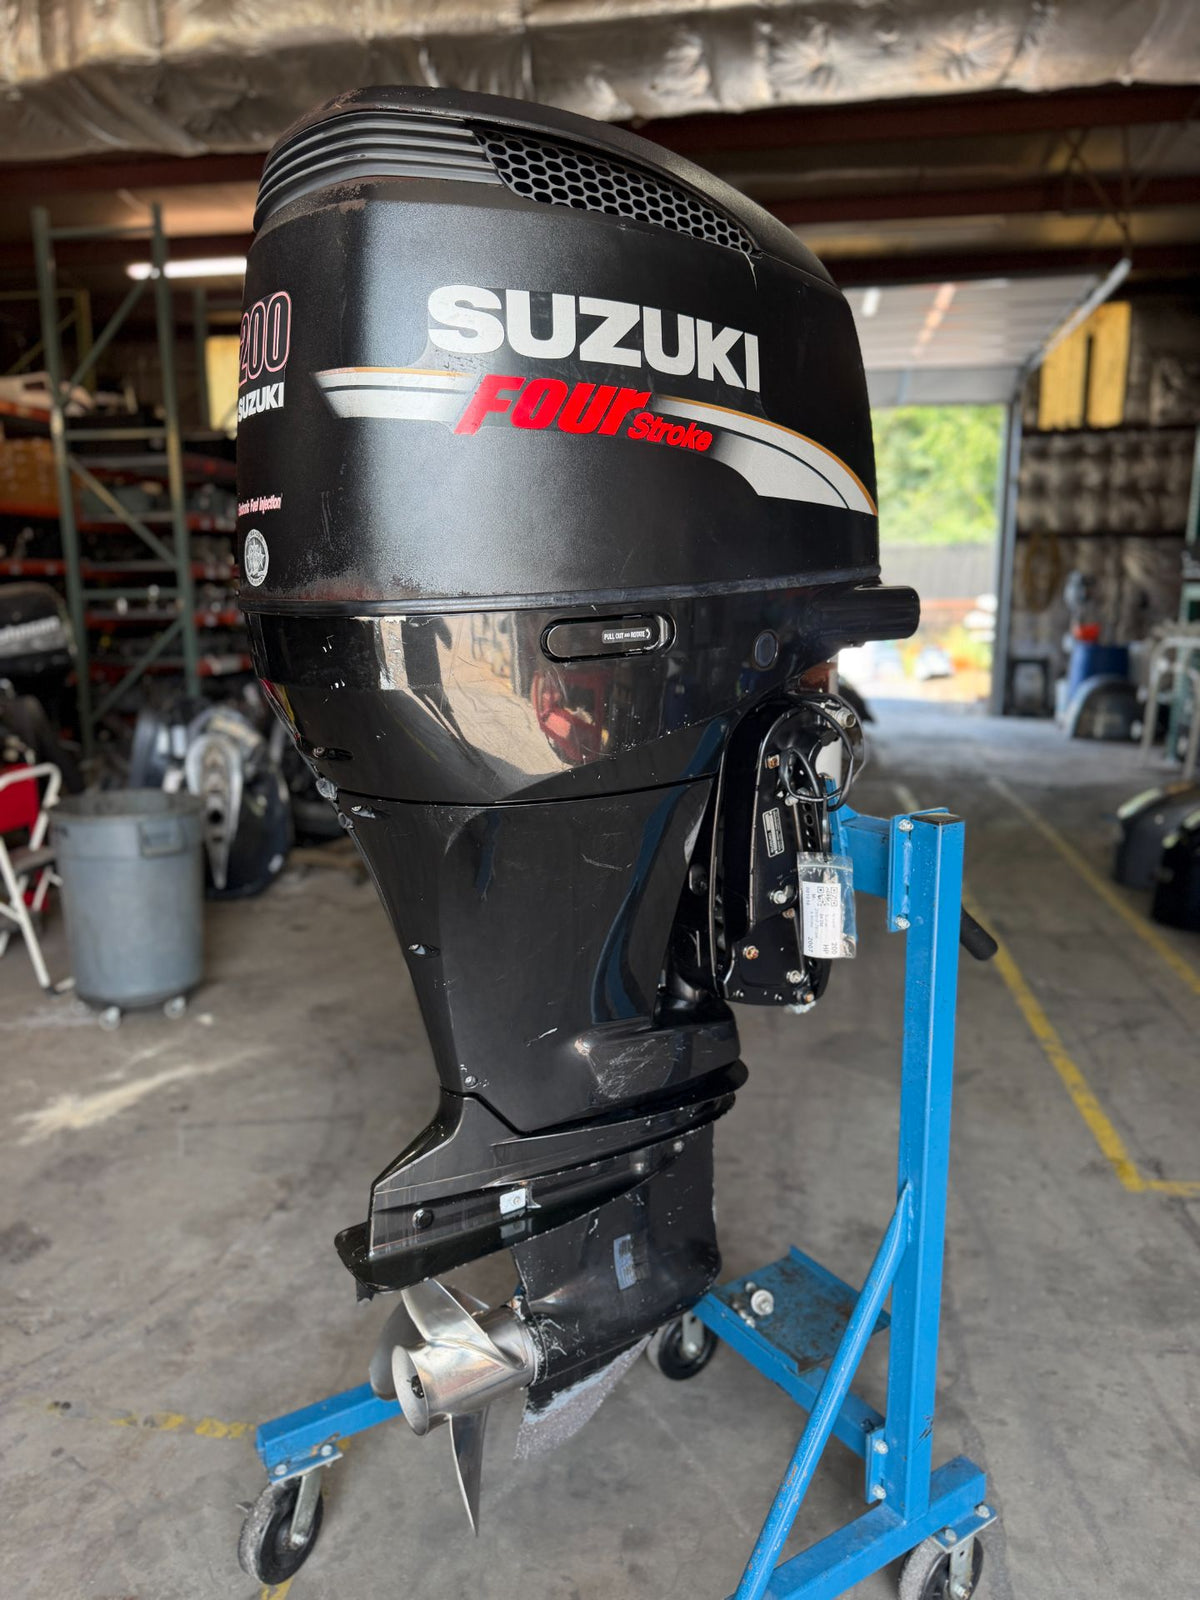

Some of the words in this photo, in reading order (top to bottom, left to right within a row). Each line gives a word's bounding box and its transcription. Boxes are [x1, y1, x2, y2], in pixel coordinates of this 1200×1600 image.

[239, 291, 292, 386] 200
[427, 284, 761, 393] SUZUKI
[238, 381, 285, 422] SUZUKI
[627, 412, 713, 452] Stroke
[259, 495, 281, 514] Injection
